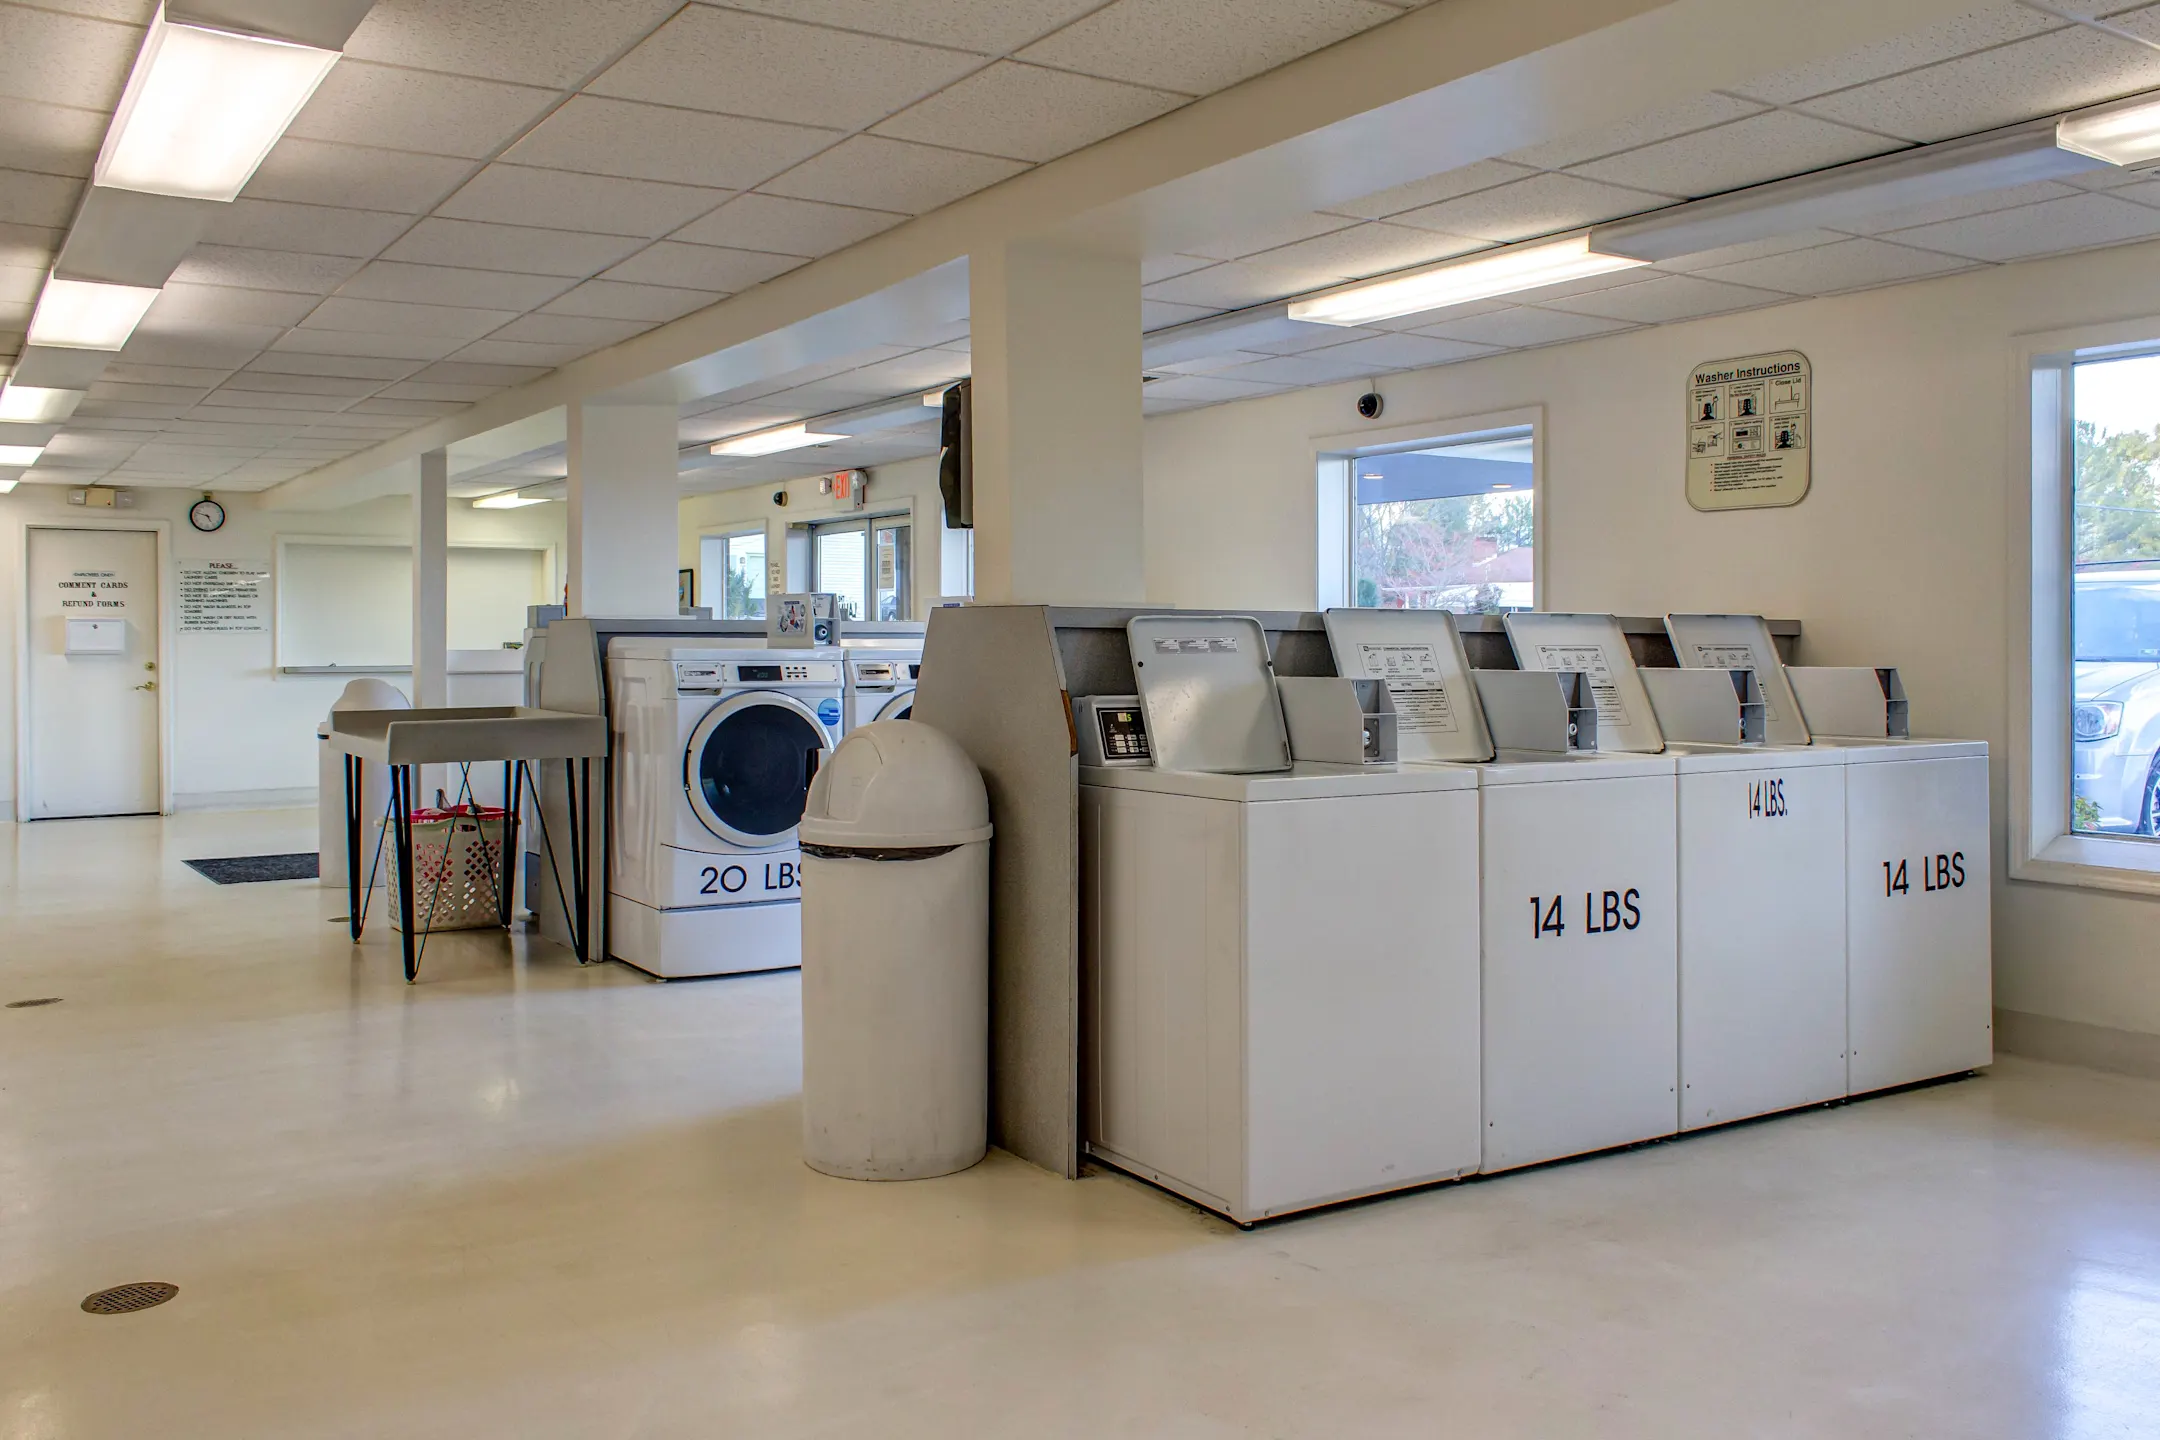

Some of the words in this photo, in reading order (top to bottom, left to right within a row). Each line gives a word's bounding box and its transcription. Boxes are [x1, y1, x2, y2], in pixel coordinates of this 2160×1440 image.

[1695, 371, 1733, 384] Washer
[1736, 362, 1801, 379] Instructions
[1775, 379, 1791, 387] Close
[1792, 377, 1802, 385] Lid
[58, 581, 97, 589] COMMENT
[100, 581, 129, 589] CARDS
[62, 600, 94, 608] REFUND
[97, 600, 126, 608] FORMS
[1749, 780, 1761, 819] 14
[700, 865, 747, 894] 20
[1883, 858, 1909, 898] 14
[1924, 851, 1965, 892] LBS
[1530, 894, 1565, 939] 14
[1586, 888, 1641, 934] LBS
